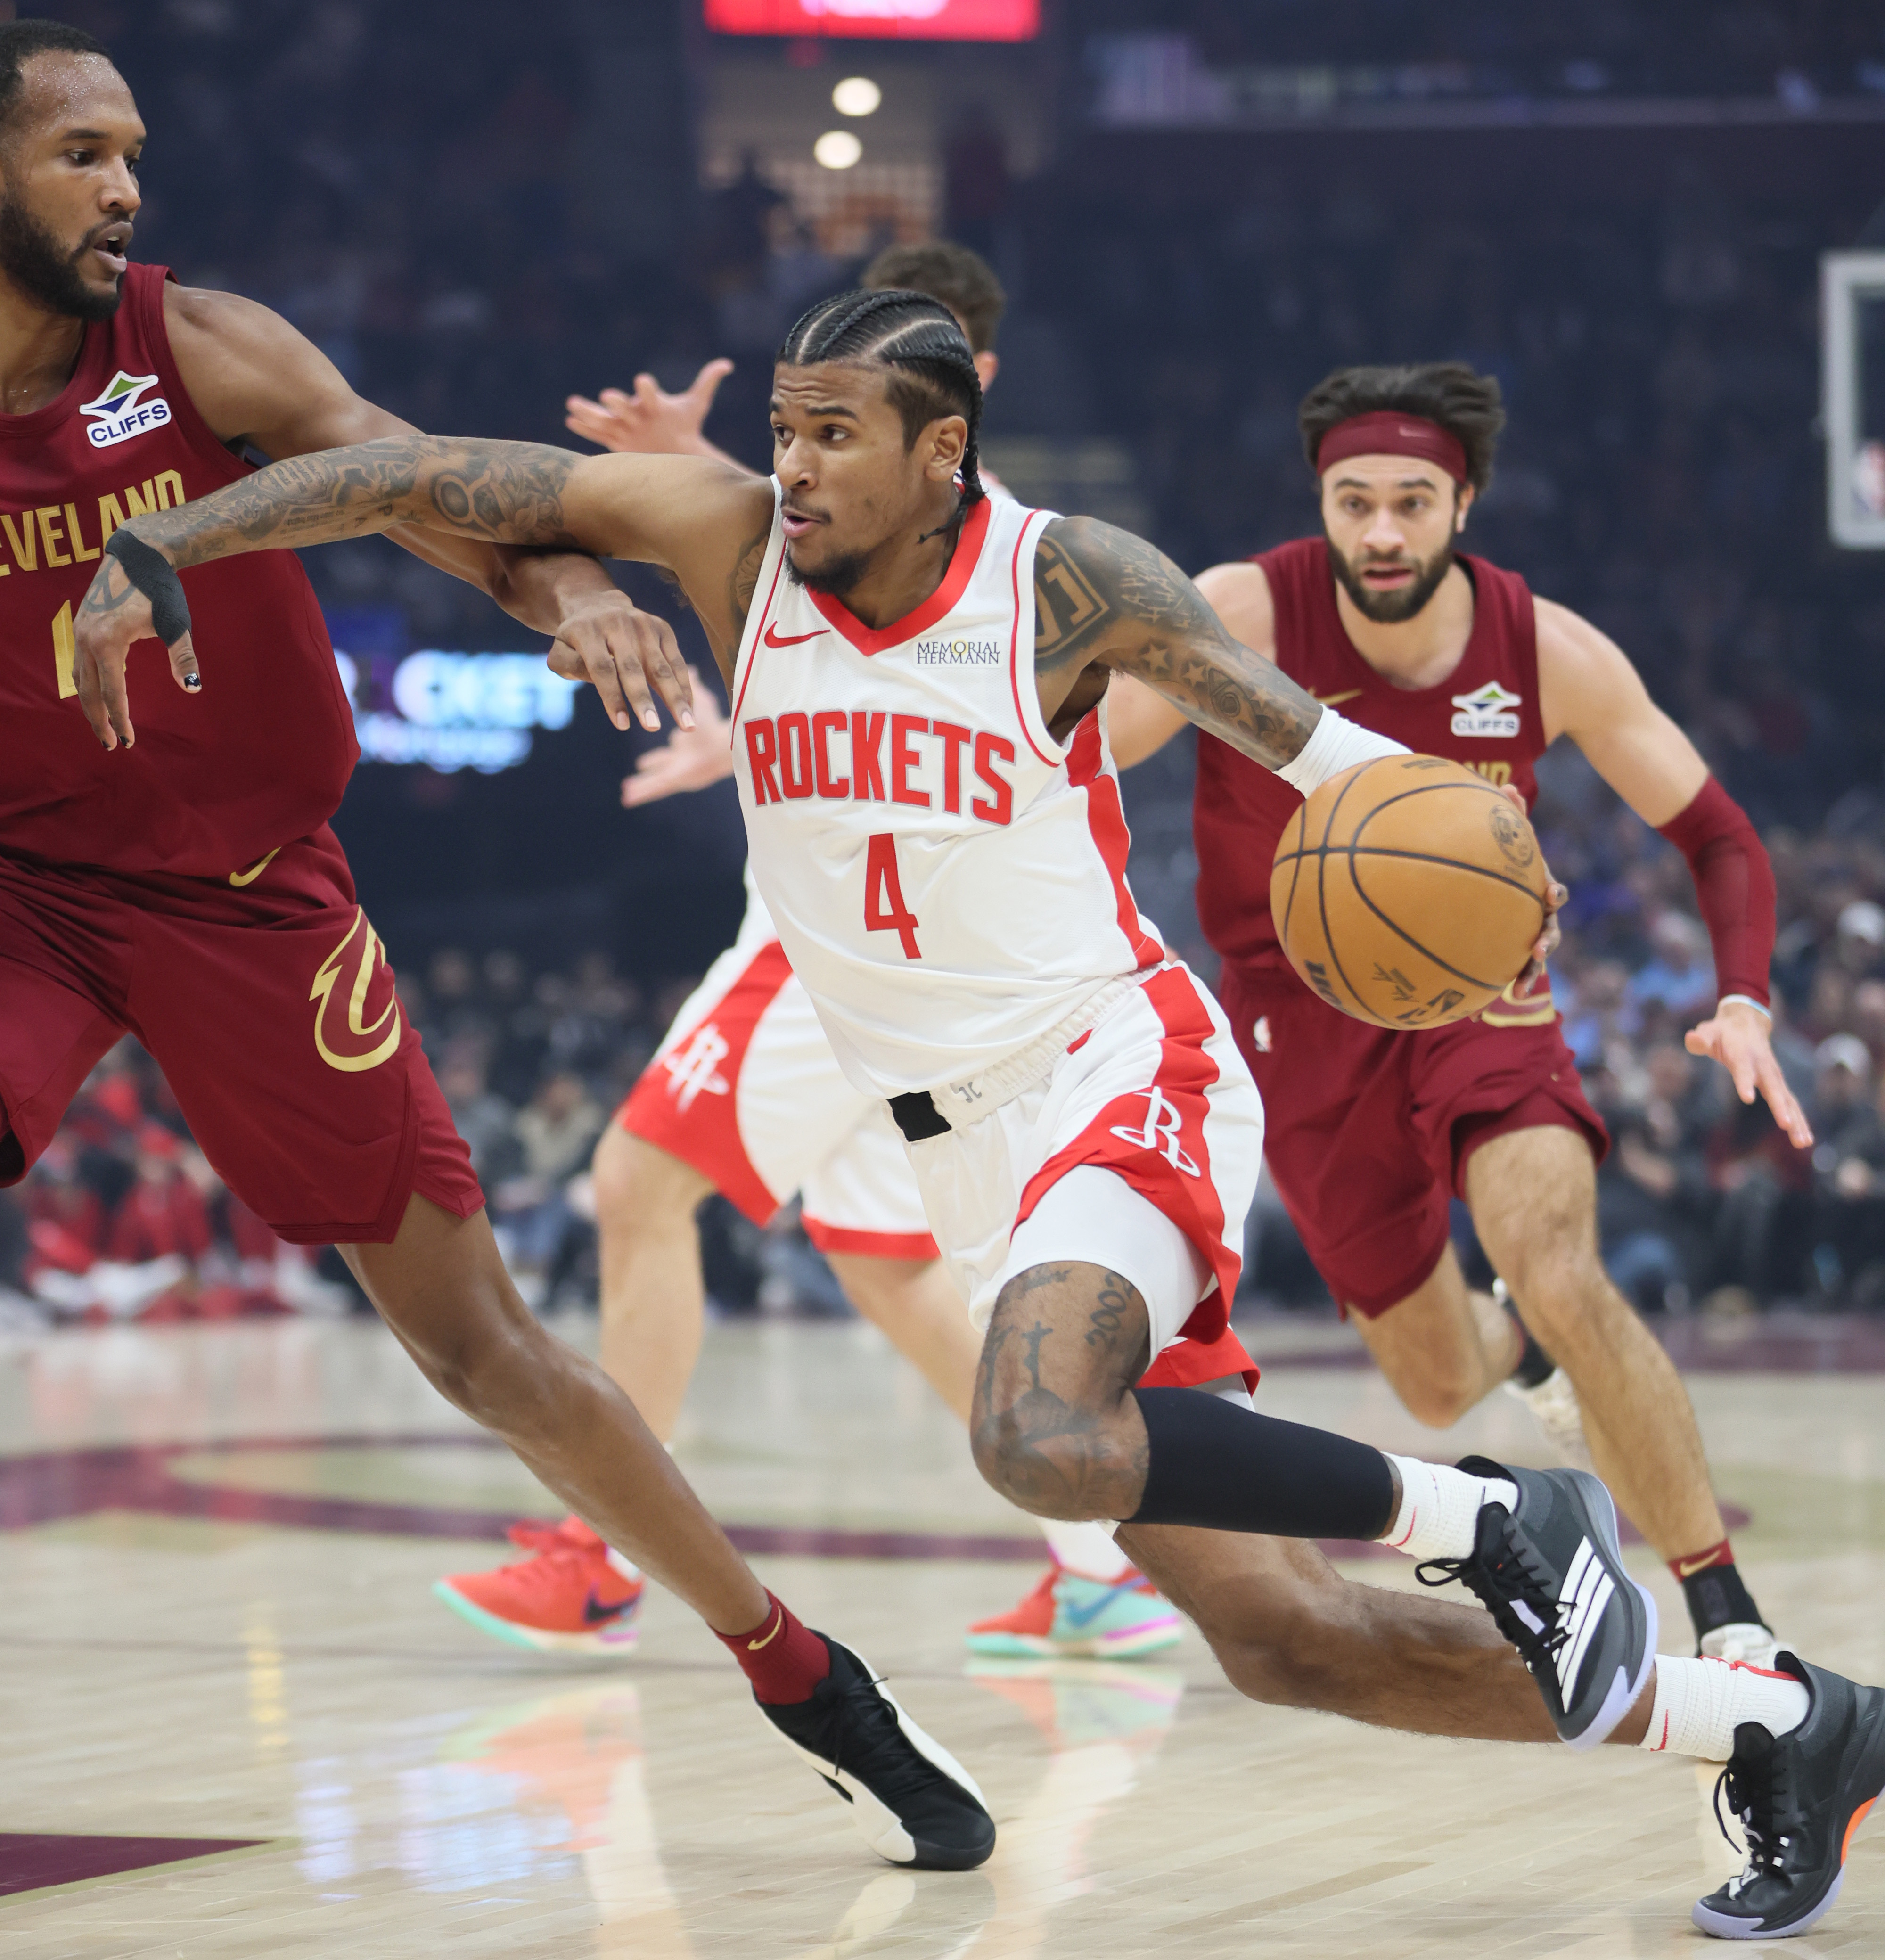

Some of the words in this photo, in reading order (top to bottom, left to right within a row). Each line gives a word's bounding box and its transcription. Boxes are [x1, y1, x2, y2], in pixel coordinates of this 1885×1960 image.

[91, 403, 168, 443] CLIFFS
[0, 469, 186, 577] VELAND
[917, 653, 999, 664] HERMANN
[918, 641, 1000, 654] MEMORIAL
[1454, 719, 1516, 732] CLIFFS
[743, 709, 1017, 828] ROCKETS
[864, 832, 922, 960] 4
